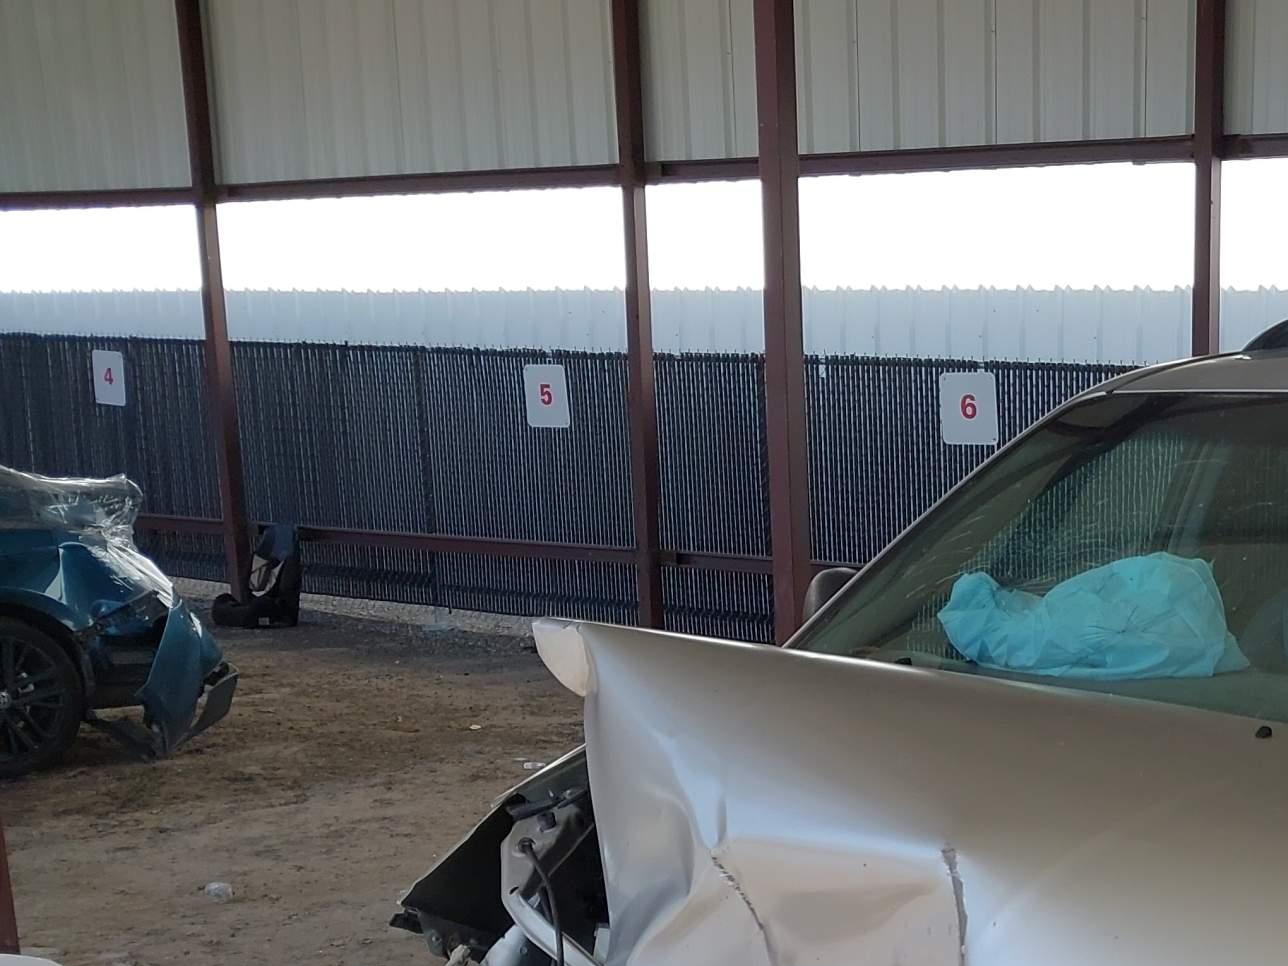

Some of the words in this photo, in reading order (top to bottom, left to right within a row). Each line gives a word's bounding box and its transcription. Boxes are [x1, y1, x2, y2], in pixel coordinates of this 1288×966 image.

[103, 367, 114, 385] 4
[539, 383, 553, 405] 5
[960, 393, 977, 419] 6
